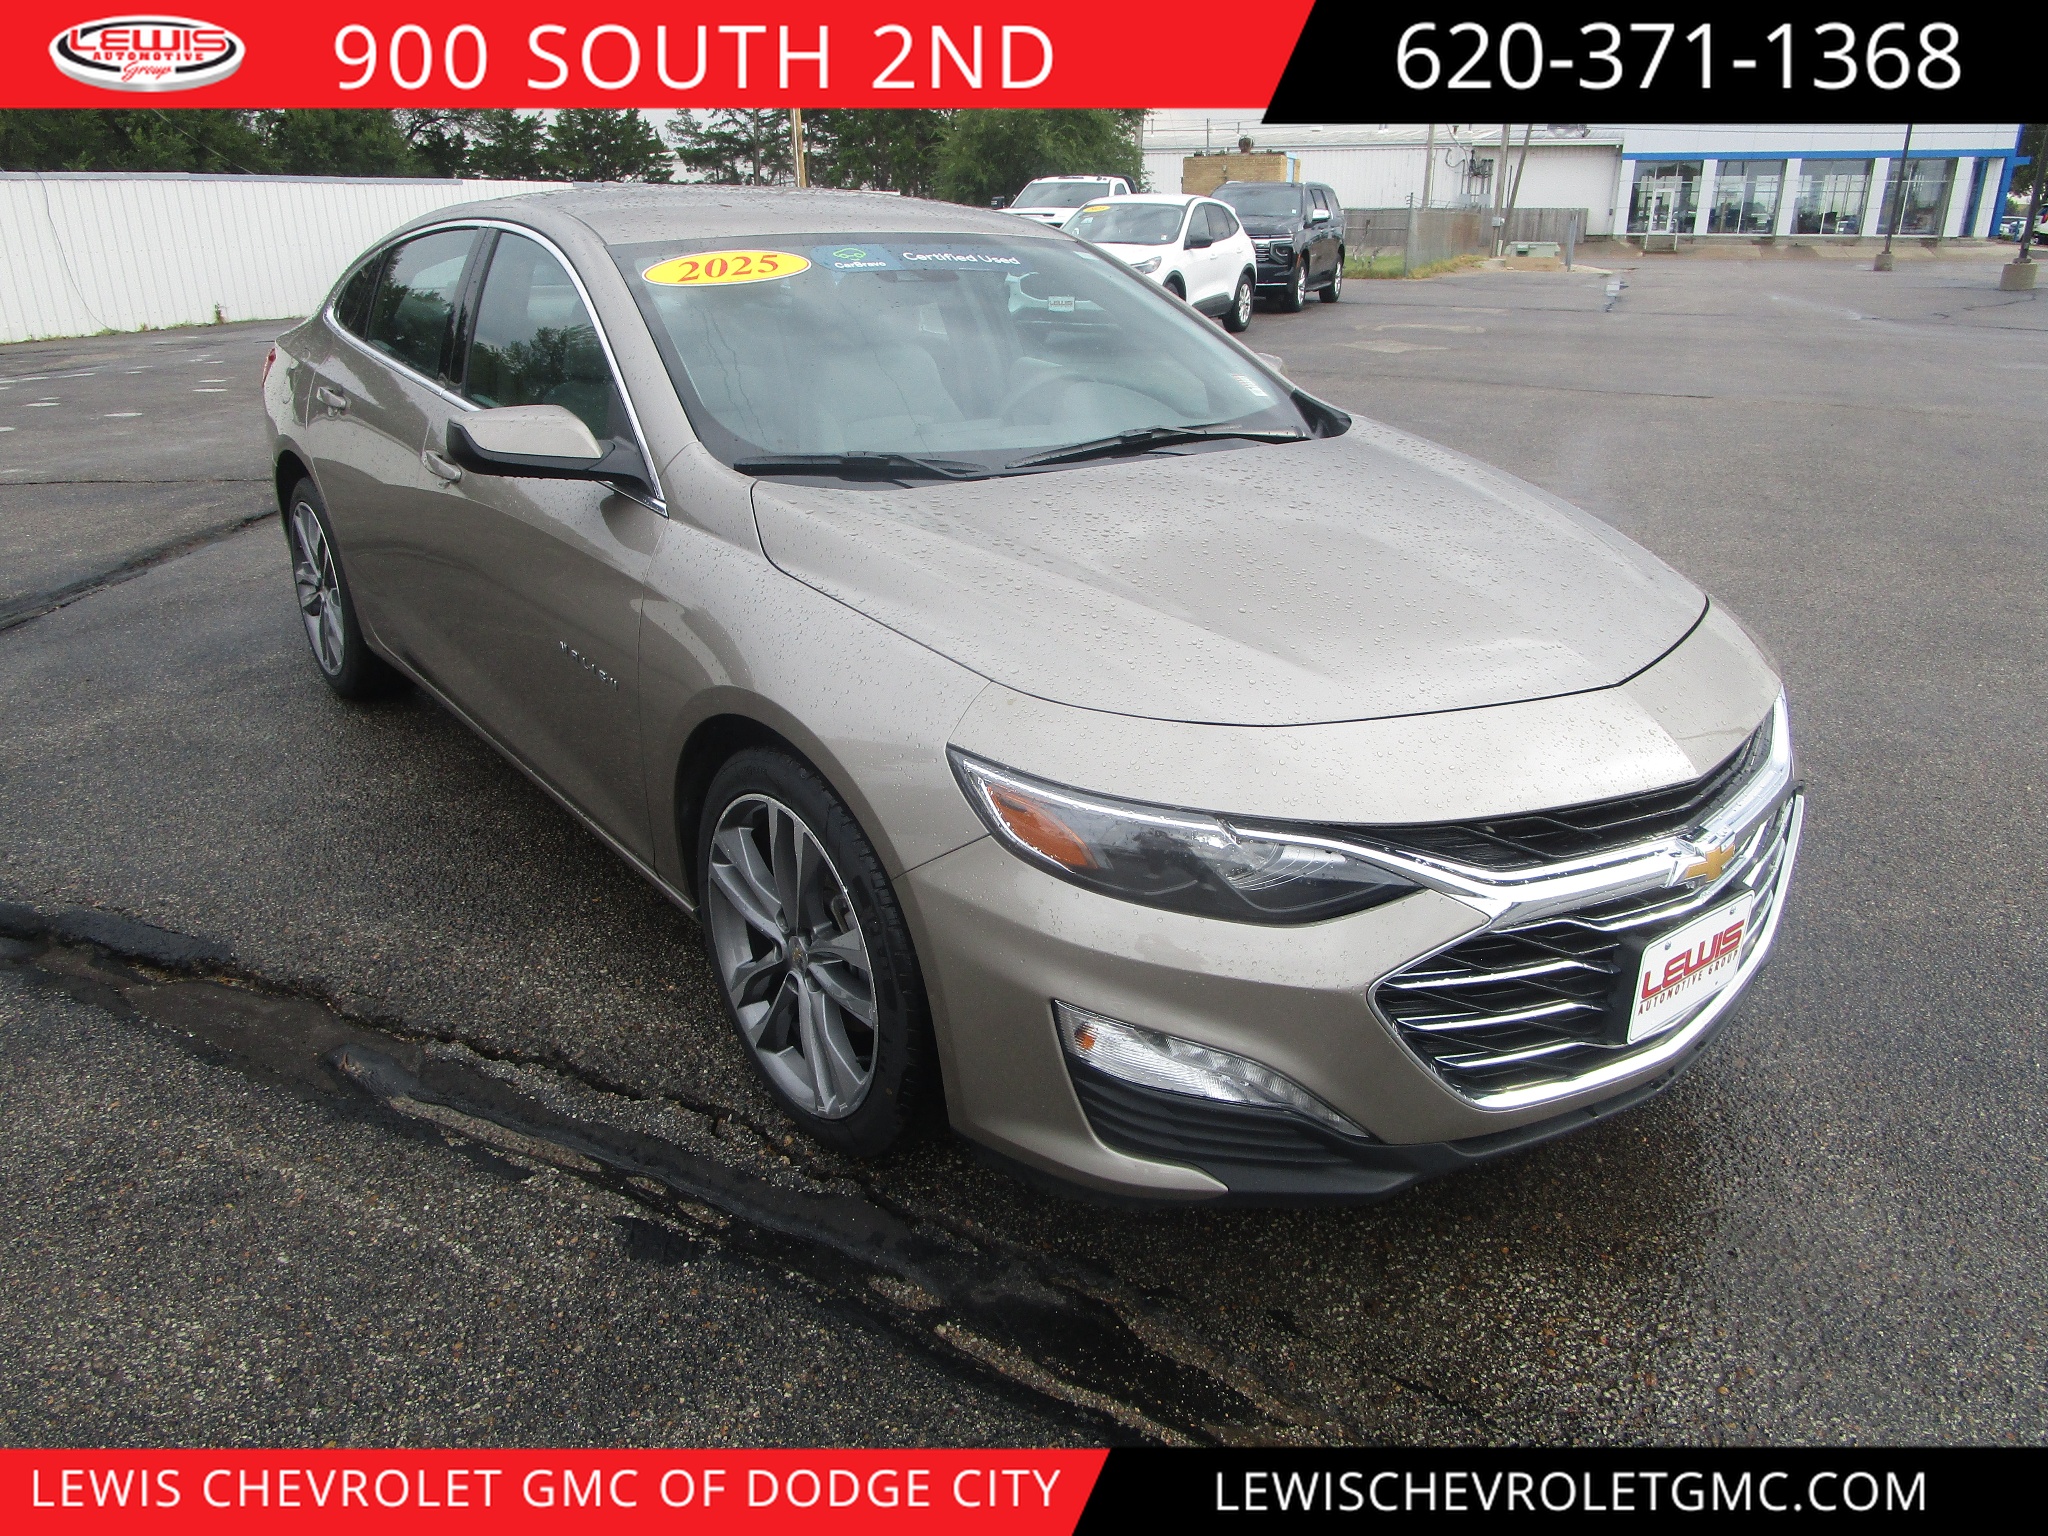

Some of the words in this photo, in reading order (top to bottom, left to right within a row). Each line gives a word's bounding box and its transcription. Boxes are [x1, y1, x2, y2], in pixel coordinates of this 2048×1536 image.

[676, 254, 779, 283] 2025
[902, 251, 979, 263] Certified
[977, 254, 1021, 266] Used
[1638, 970, 1703, 1015] AUTOMOTIVE
[1707, 949, 1740, 976] GROUP
[1641, 920, 1745, 999] LEWIS
